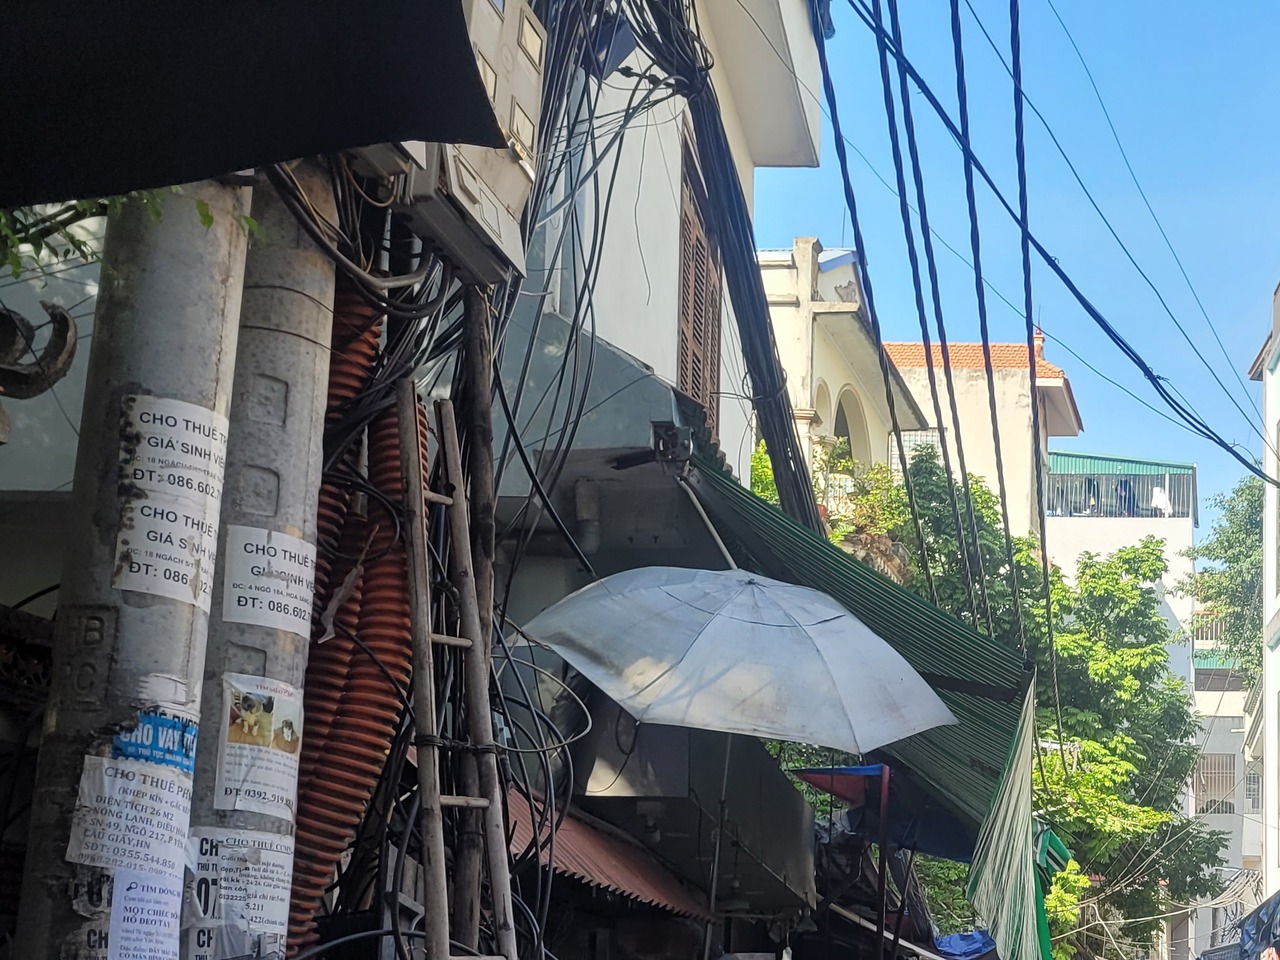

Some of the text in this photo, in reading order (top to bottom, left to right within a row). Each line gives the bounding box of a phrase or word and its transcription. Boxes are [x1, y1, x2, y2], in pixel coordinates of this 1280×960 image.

[140, 412, 177, 428] CHO
[182, 418, 218, 440] THUÊ
[148, 436, 175, 450] GIÁ
[181, 442, 212, 460] SINH
[134, 468, 163, 482] ĐT:
[140, 505, 213, 538] CHO THUÊ
[146, 530, 206, 556] GIÁ SNH
[244, 542, 309, 568] CHO THUÊ
[130, 562, 157, 577] ĐT:
[237, 596, 263, 609] ĐT:
[158, 727, 182, 751] VAY
[104, 766, 136, 782] CHO
[140, 774, 174, 793] THUÊ
[150, 807, 161, 816] 26
[163, 812, 174, 821] M2
[140, 884, 156, 894] TÌM
[124, 906, 145, 916] MỘT
